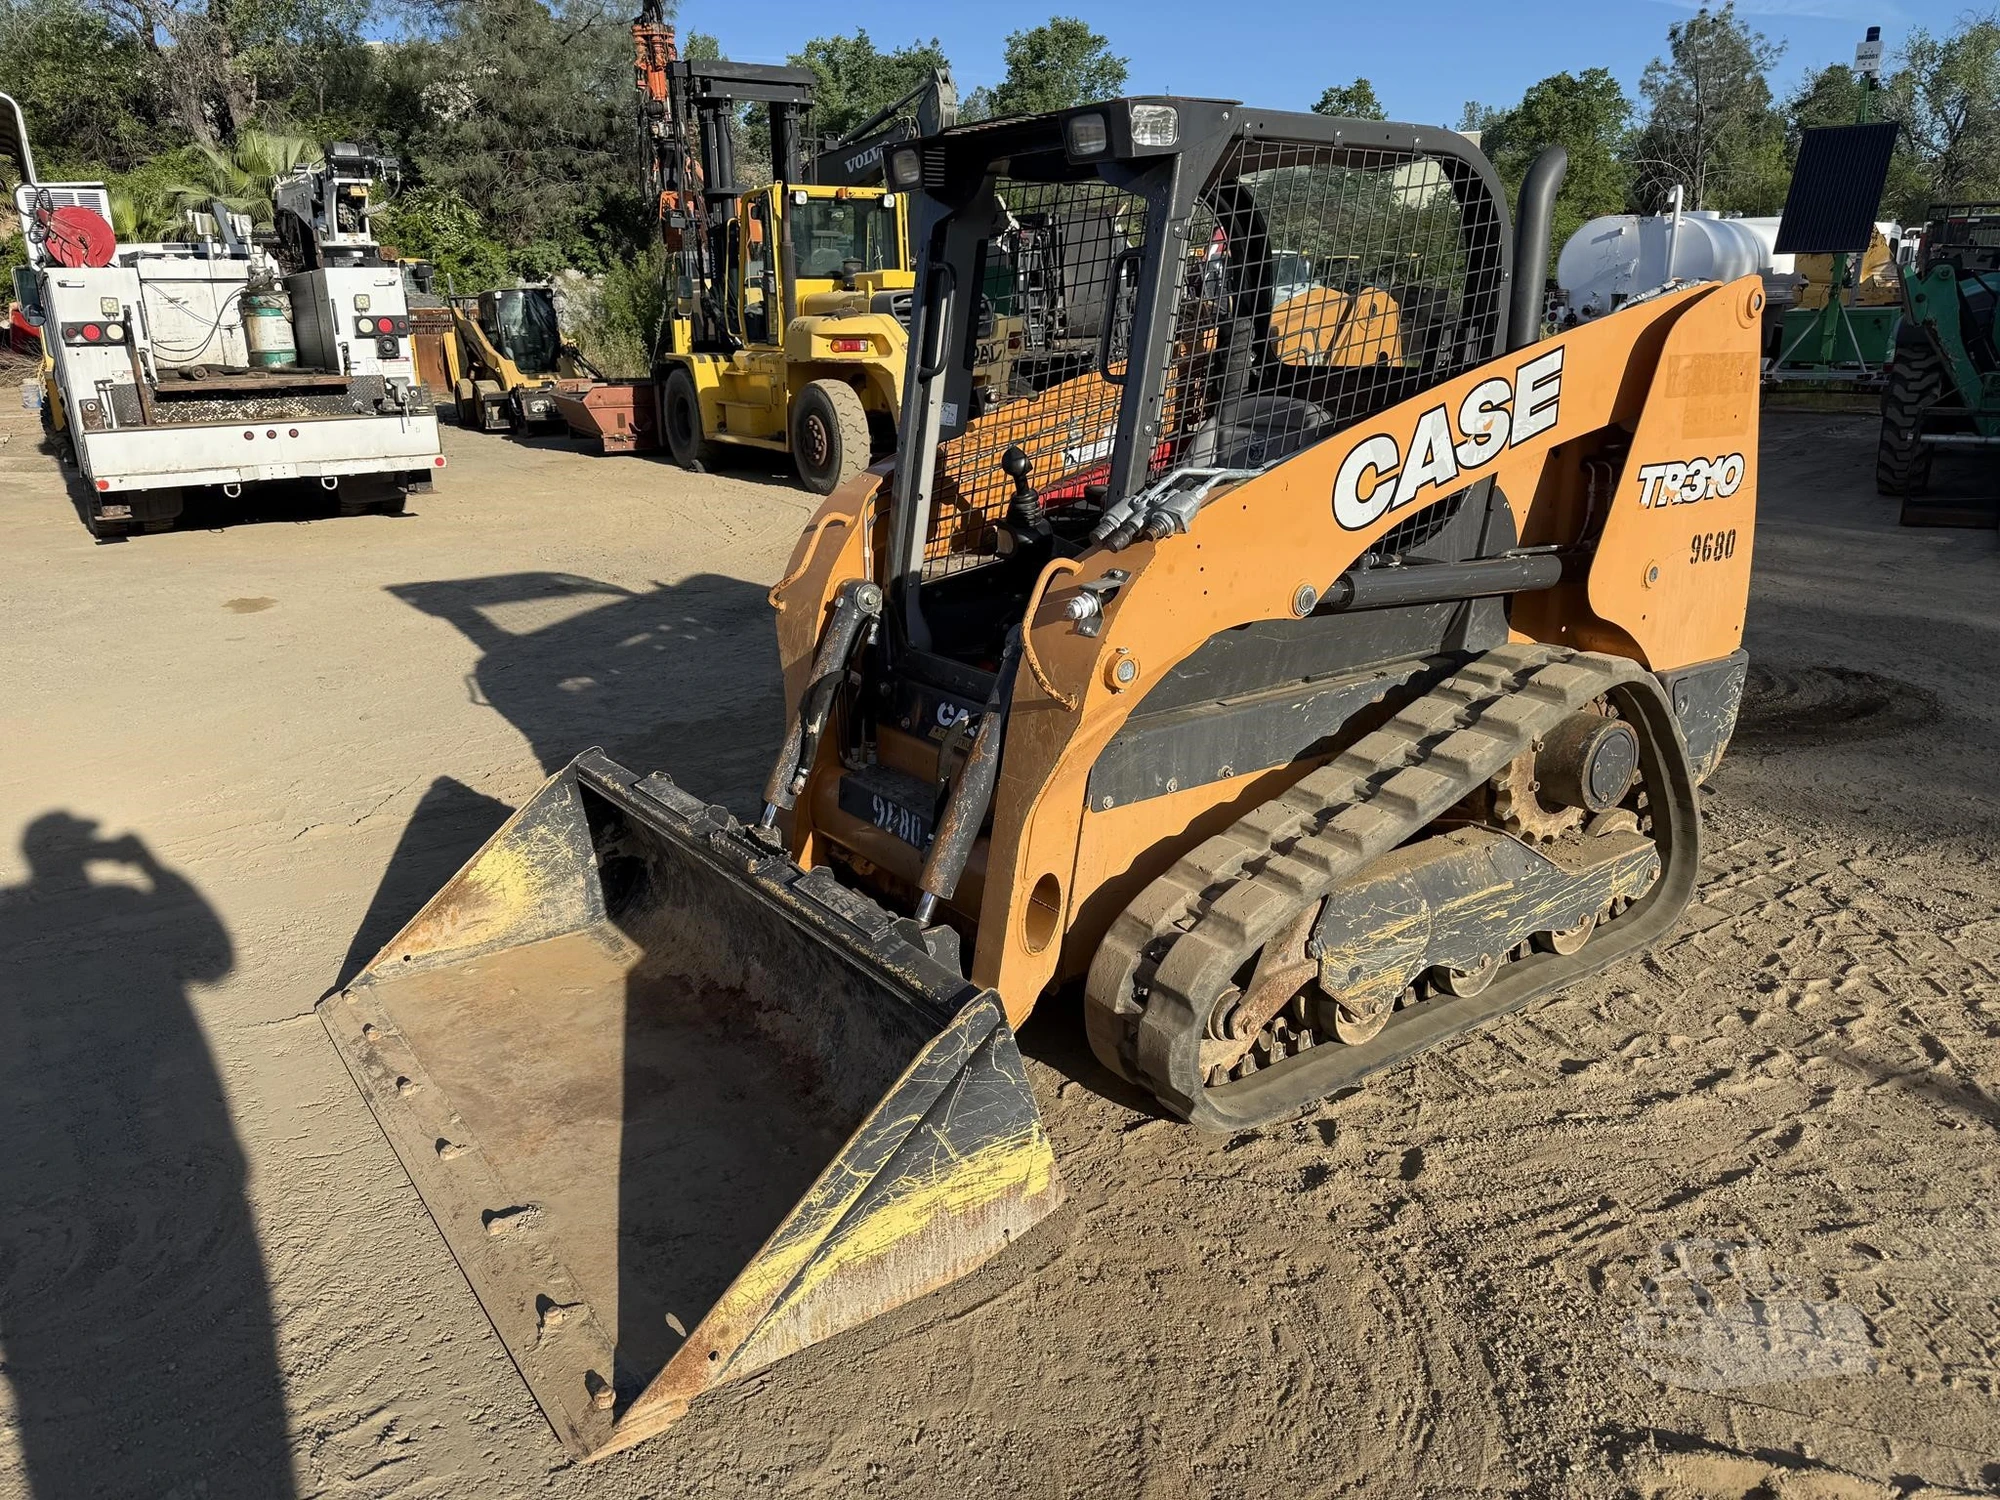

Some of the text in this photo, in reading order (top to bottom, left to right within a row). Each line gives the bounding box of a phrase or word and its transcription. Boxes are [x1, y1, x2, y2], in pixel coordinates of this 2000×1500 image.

[845, 140, 890, 173] VOLV
[1332, 344, 1566, 531] CASE
[1637, 452, 1745, 509] TR310
[1690, 528, 1736, 565] 9680
